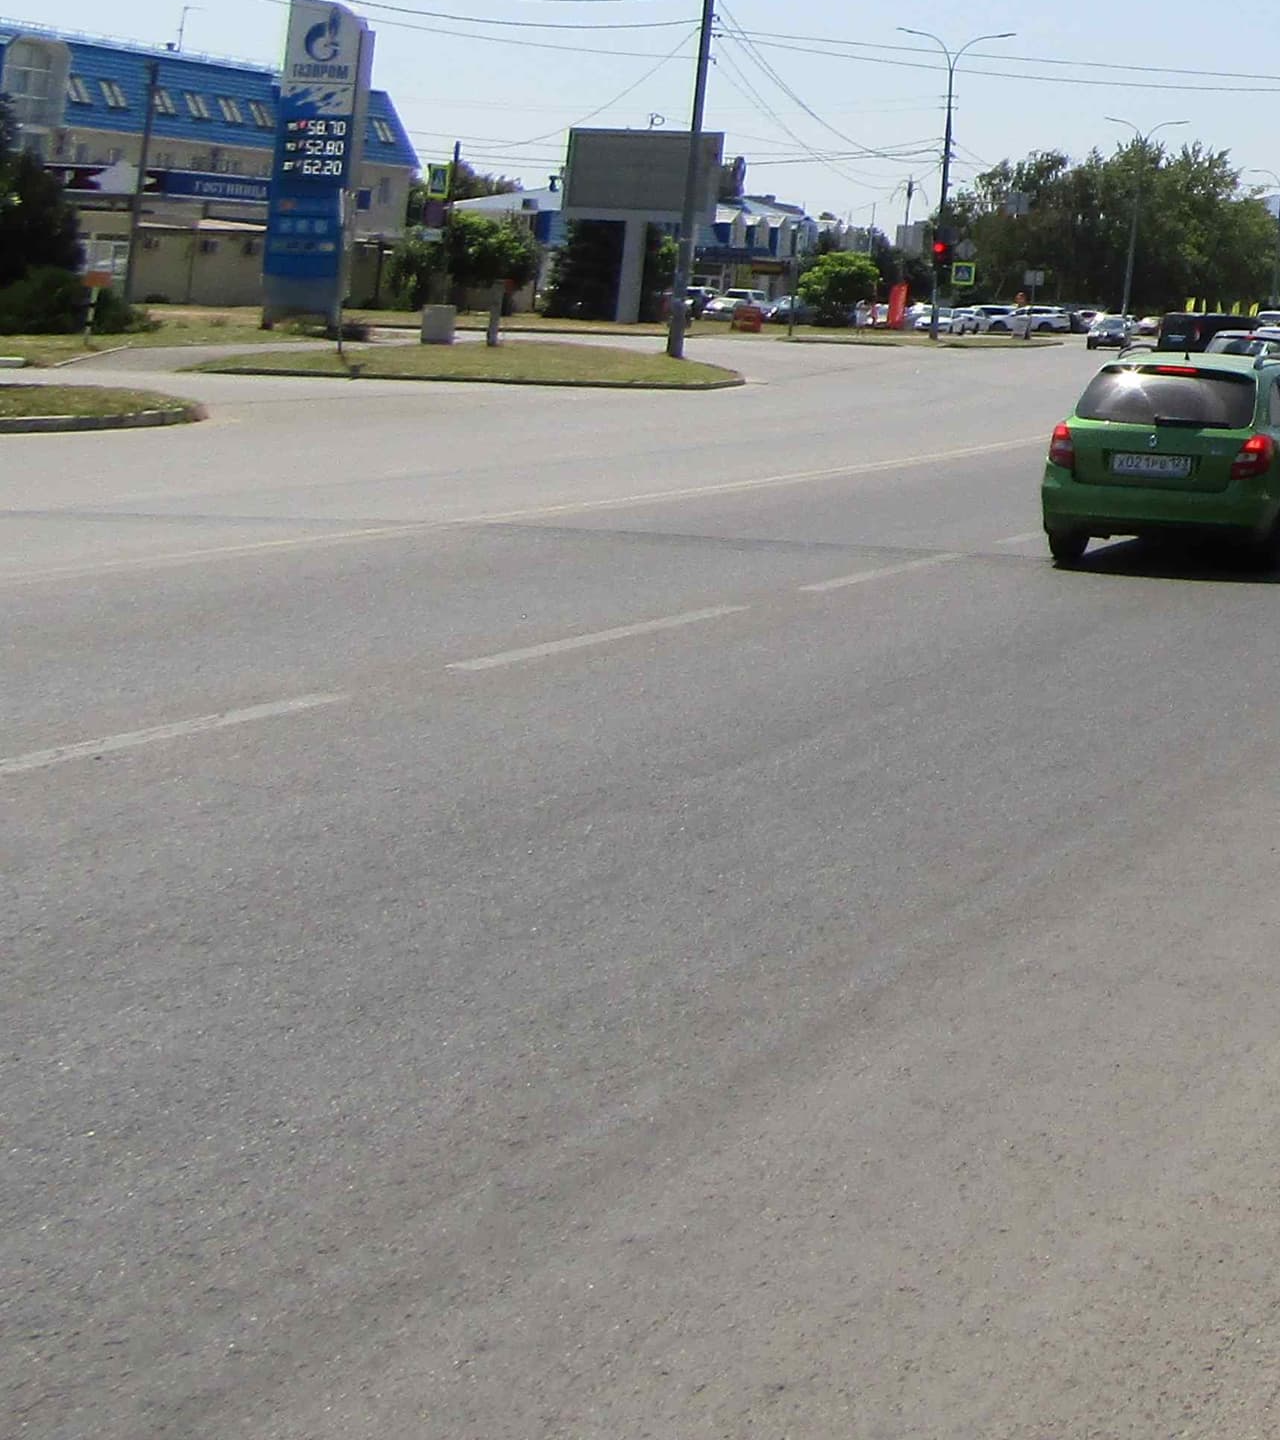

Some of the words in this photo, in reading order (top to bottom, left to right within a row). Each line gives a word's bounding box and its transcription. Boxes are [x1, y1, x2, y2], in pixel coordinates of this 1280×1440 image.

[293, 64, 348, 79] ГАЗПРОМ
[306, 120, 346, 136] 58.70
[304, 140, 344, 156] 52.80
[302, 159, 343, 176] 62.20
